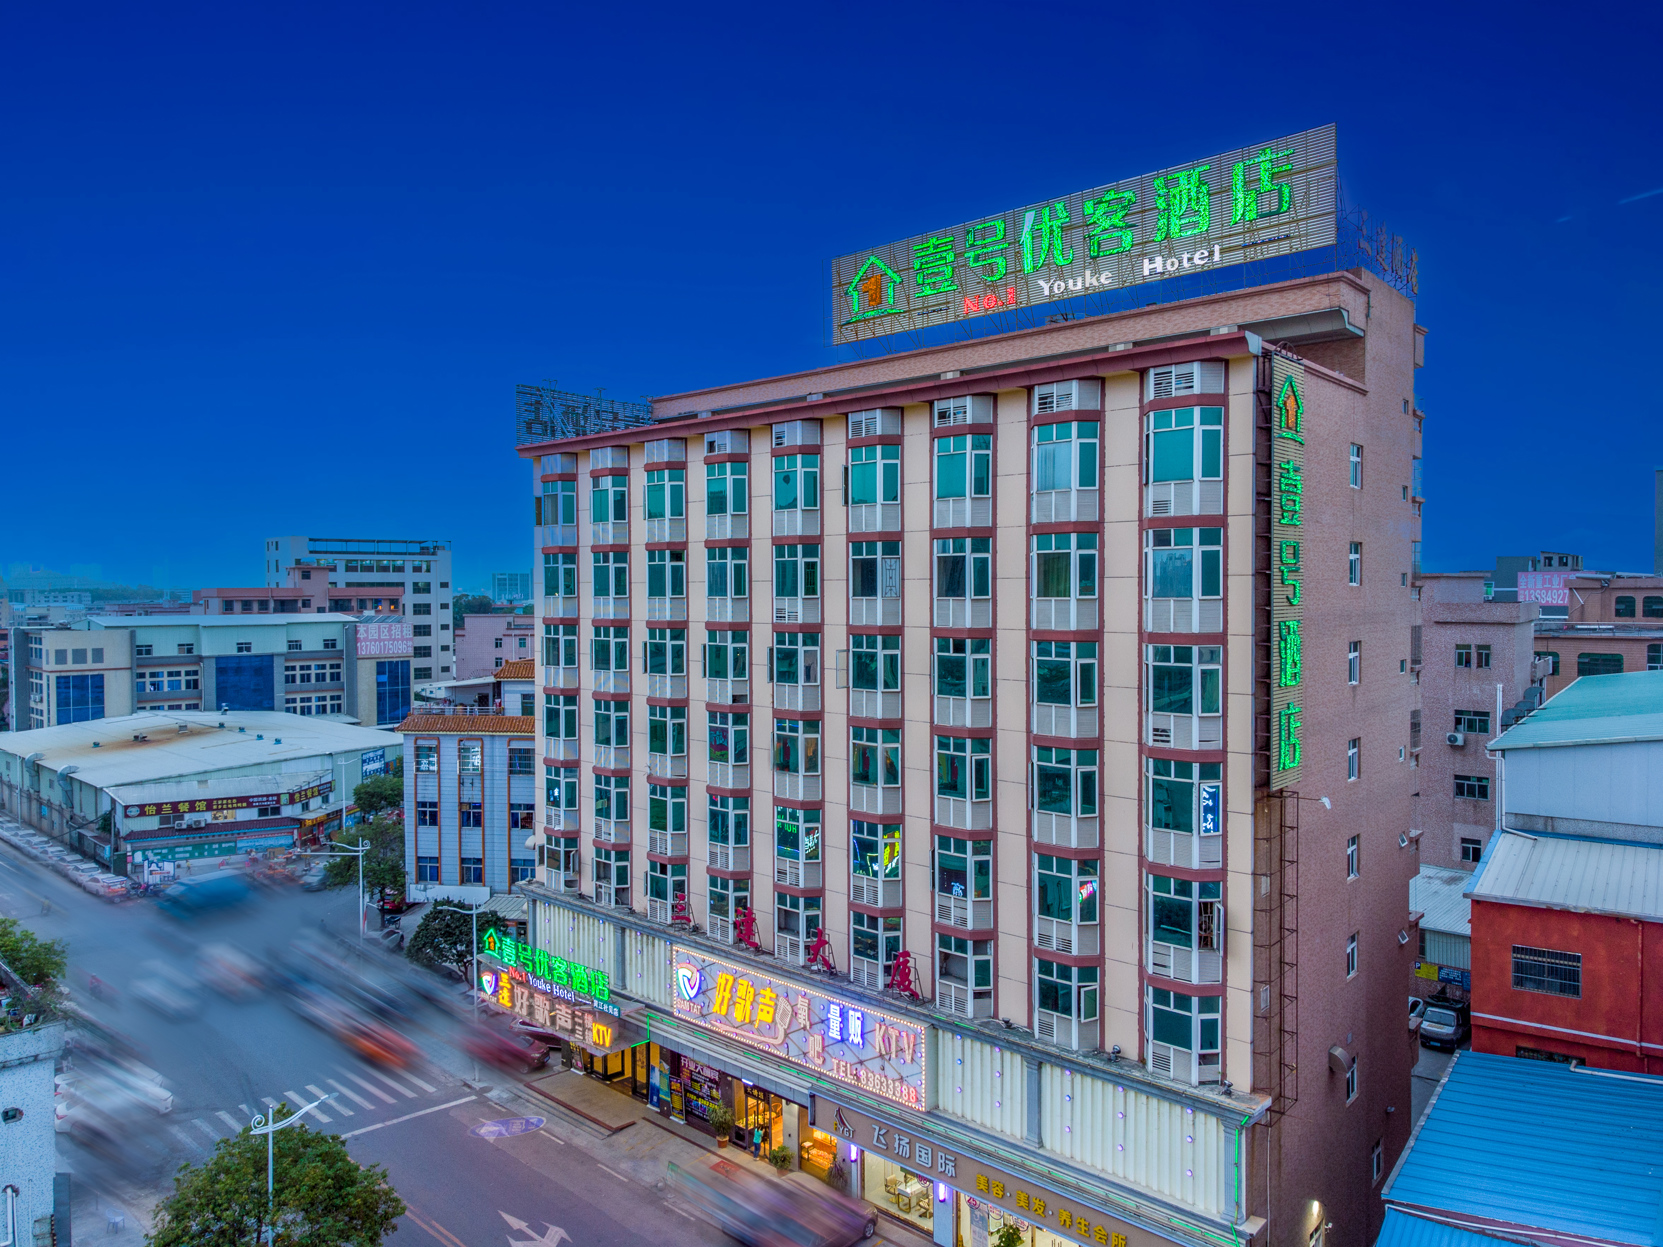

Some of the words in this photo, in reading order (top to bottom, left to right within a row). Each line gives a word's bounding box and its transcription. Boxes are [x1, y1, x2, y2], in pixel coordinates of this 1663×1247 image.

[912, 146, 1296, 298] 壹号优客酒店
[963, 287, 1017, 315] No.1
[1038, 270, 1114, 296] Youke
[1143, 244, 1222, 276] Hotel
[356, 624, 413, 640] 本园区招租
[1278, 459, 1303, 773] 壹号酒店
[356, 640, 407, 656] 13760175096
[144, 801, 207, 816] 怡兰餐馆
[502, 936, 610, 1002] 壹号优客酒店
[509, 966, 527, 983] No.1
[528, 973, 551, 993] Youke
[553, 984, 575, 1002] Hotel
[513, 985, 572, 1030] 好歌声
[676, 998, 689, 1011] SAM
[690, 1002, 702, 1015] TAT
[712, 972, 777, 1028] 好歌声
[592, 1022, 612, 1047] KTV
[875, 1022, 916, 1064] KTV
[871, 1124, 957, 1177] 飞扬国际
